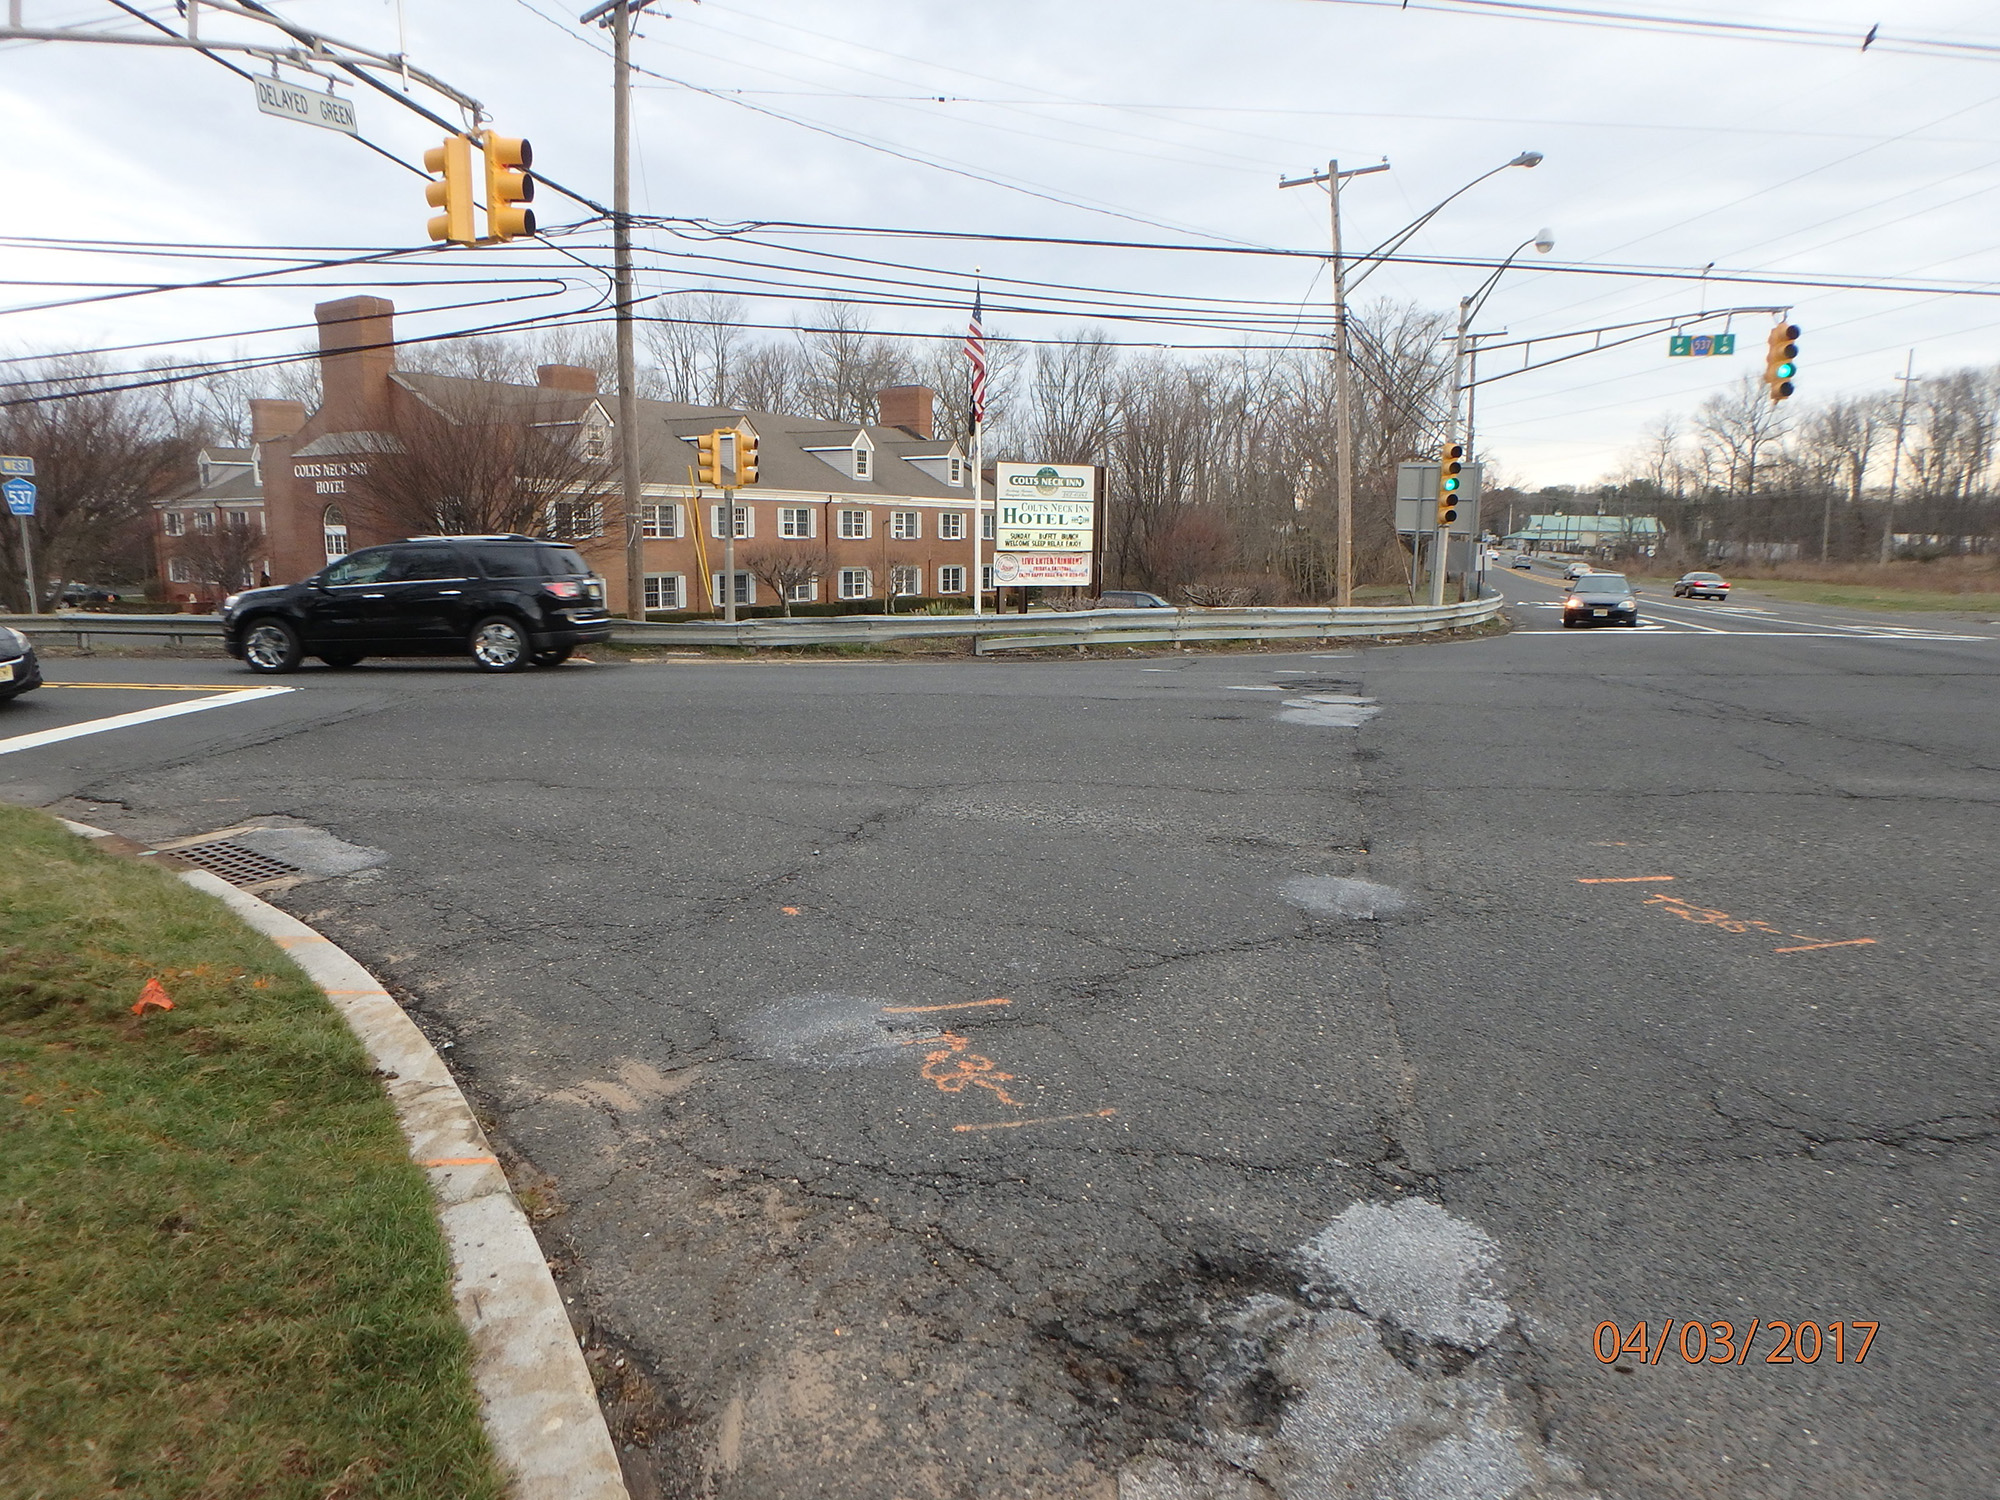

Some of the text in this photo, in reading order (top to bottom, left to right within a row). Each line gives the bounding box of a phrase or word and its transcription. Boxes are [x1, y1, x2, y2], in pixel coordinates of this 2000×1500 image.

[258, 82, 354, 126] DELAYED GREEN
[1694, 340, 1712, 350] 537
[3, 460, 29, 471] WEST
[294, 464, 321, 478] COLTS
[315, 480, 347, 494] HOTEL
[1012, 476, 1082, 487] COLTS NECK INN
[8, 490, 32, 505] 537
[1021, 502, 1090, 513] COLTS NECK INN
[1003, 507, 1069, 525] HOTEL
[1021, 557, 1083, 565] LIVE ENTERTAINMENT
